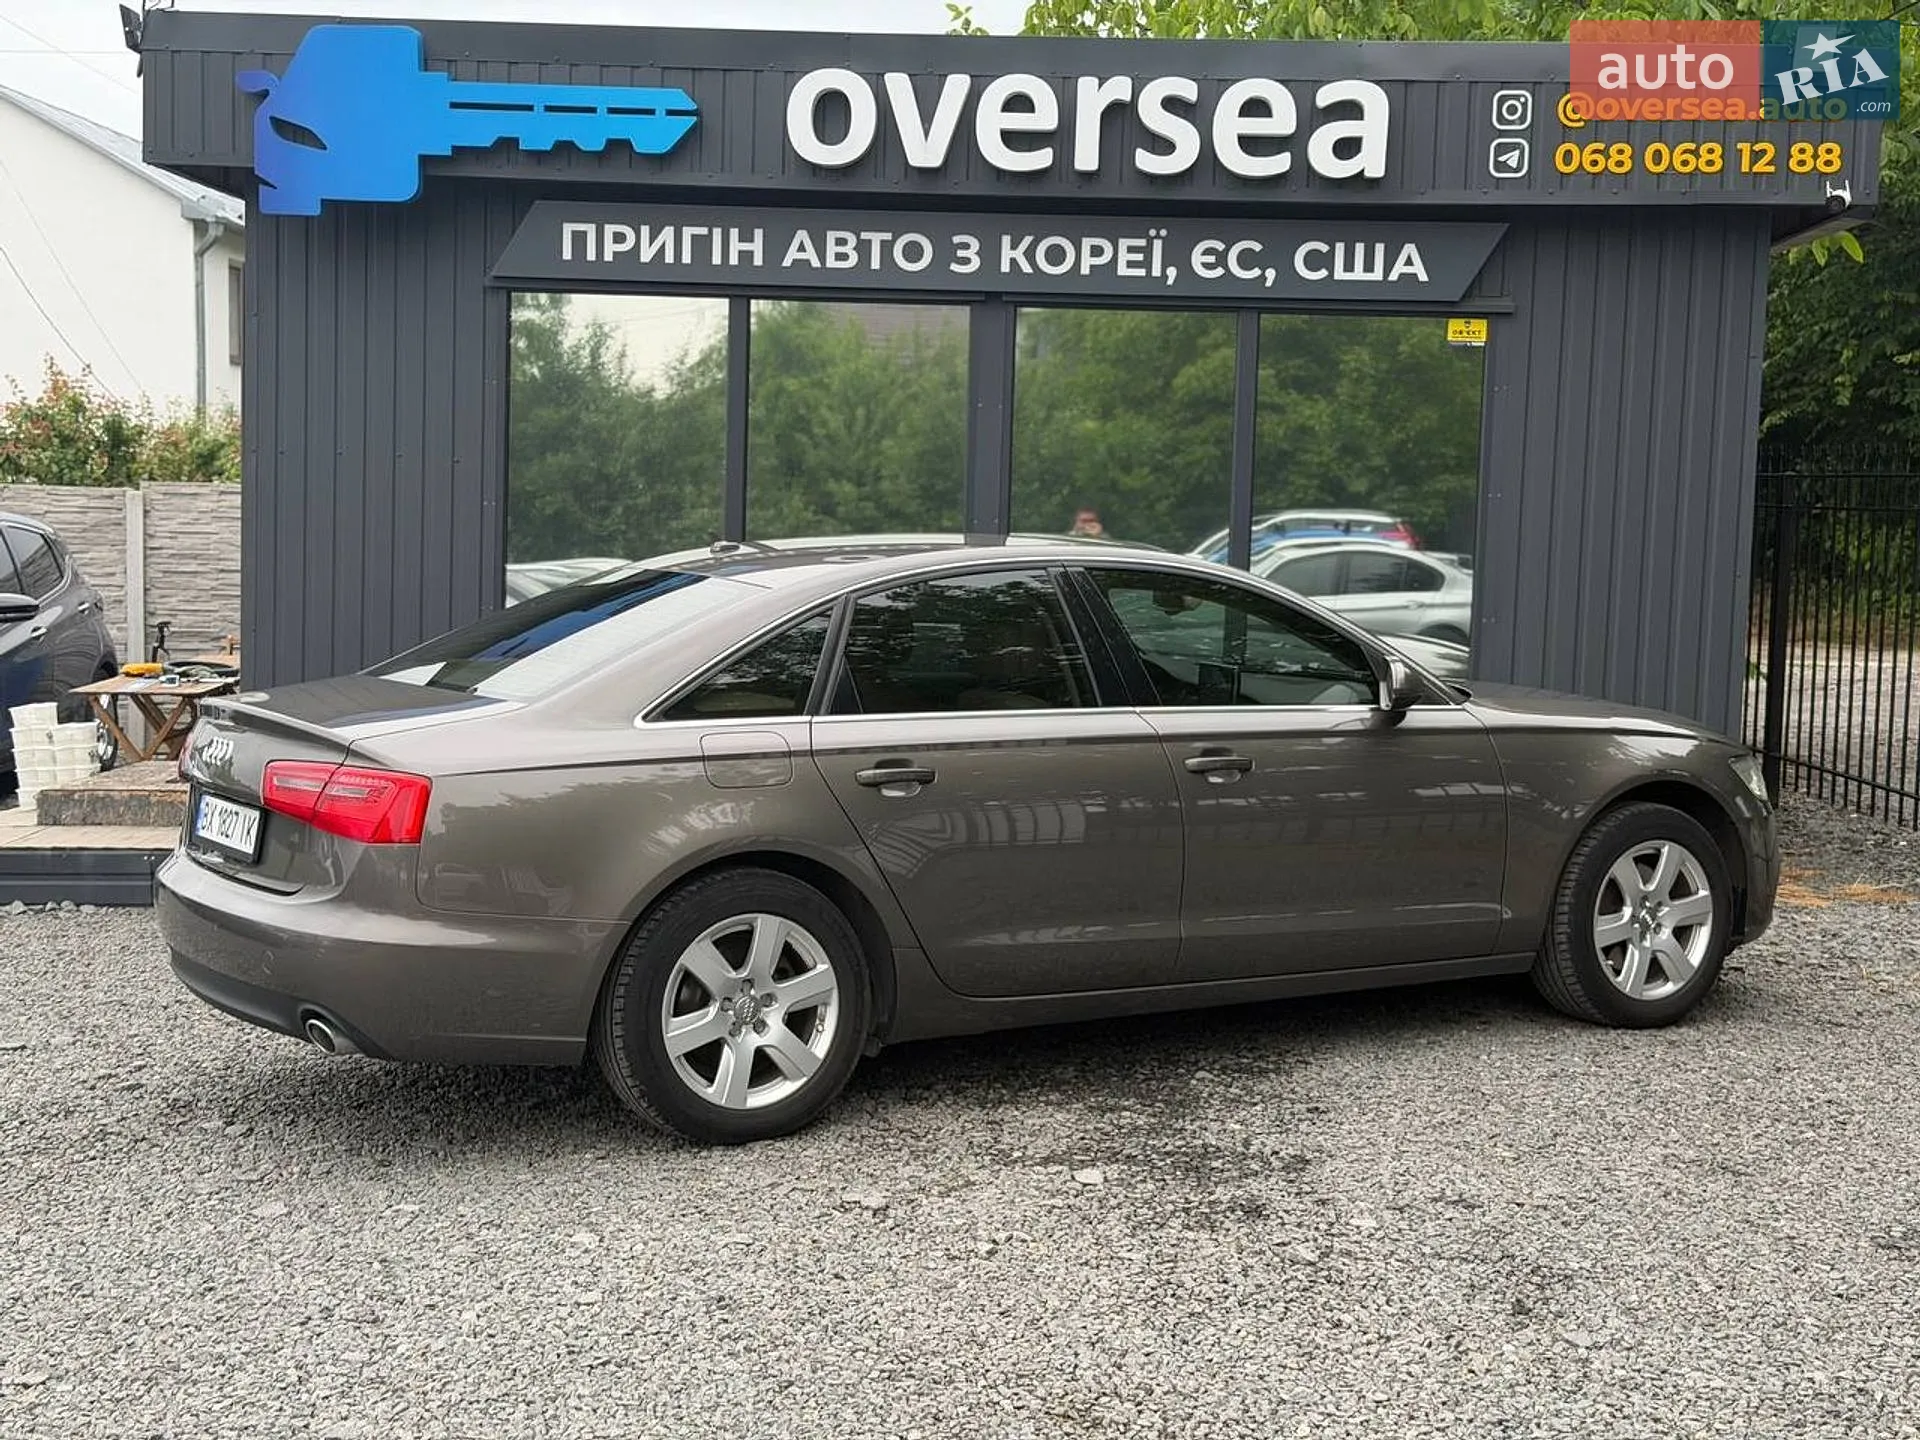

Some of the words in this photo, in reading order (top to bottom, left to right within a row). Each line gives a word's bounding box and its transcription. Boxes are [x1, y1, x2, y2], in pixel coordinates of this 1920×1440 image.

[786, 68, 1390, 178] oversea
[1556, 92, 1848, 128] @oversea.auto
[1554, 142, 1633, 174] 068
[1644, 143, 1724, 174] 068
[1737, 143, 1776, 173] 12
[1788, 143, 1842, 174] 88
[560, 222, 764, 267] ПРИГІН
[780, 230, 933, 272] АВТО
[1001, 228, 1178, 286] КОРЕЇ,
[1191, 240, 1277, 287] ЄС,
[1293, 242, 1430, 283] США
